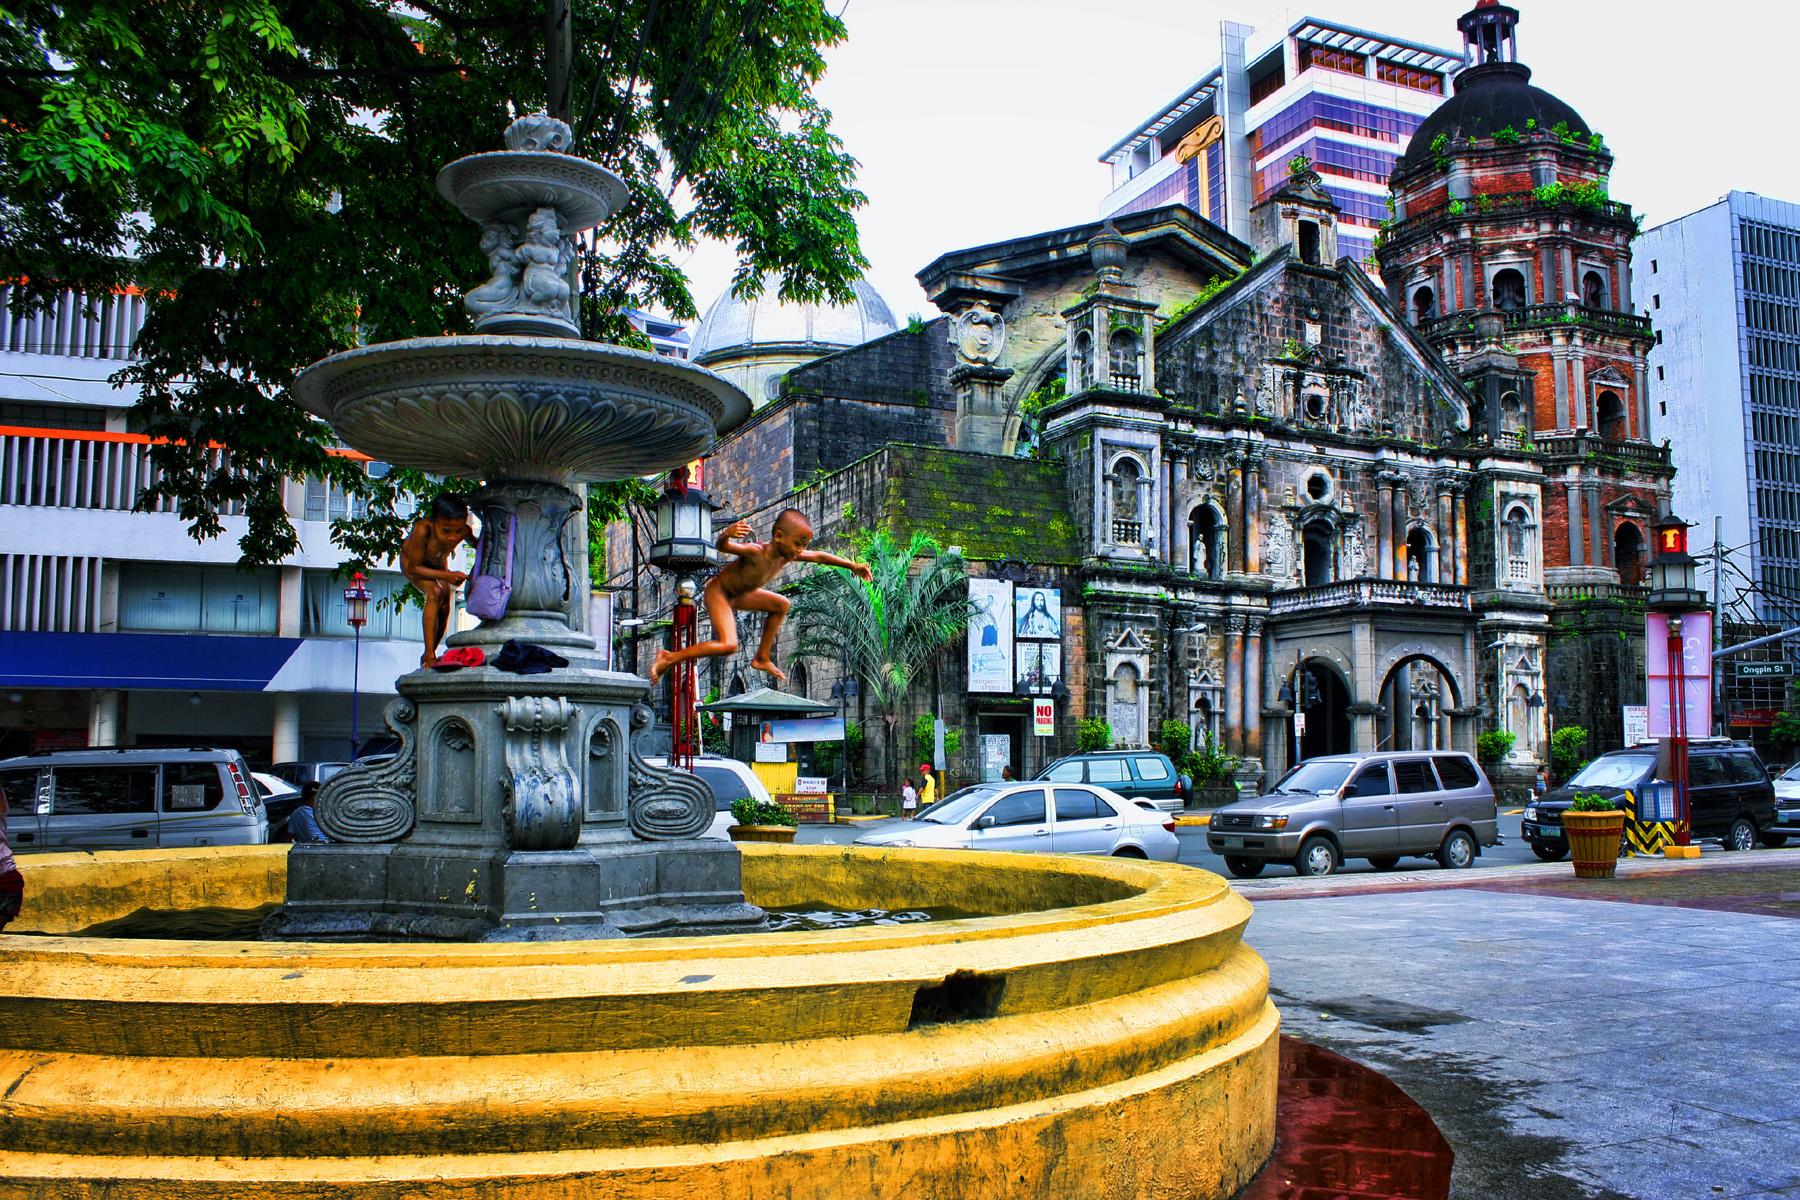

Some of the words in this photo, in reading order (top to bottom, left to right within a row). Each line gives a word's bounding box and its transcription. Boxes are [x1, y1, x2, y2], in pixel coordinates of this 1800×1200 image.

[1743, 665, 1772, 675] Ongpin
[1774, 665, 1784, 673] St
[1036, 705, 1052, 717] NO
